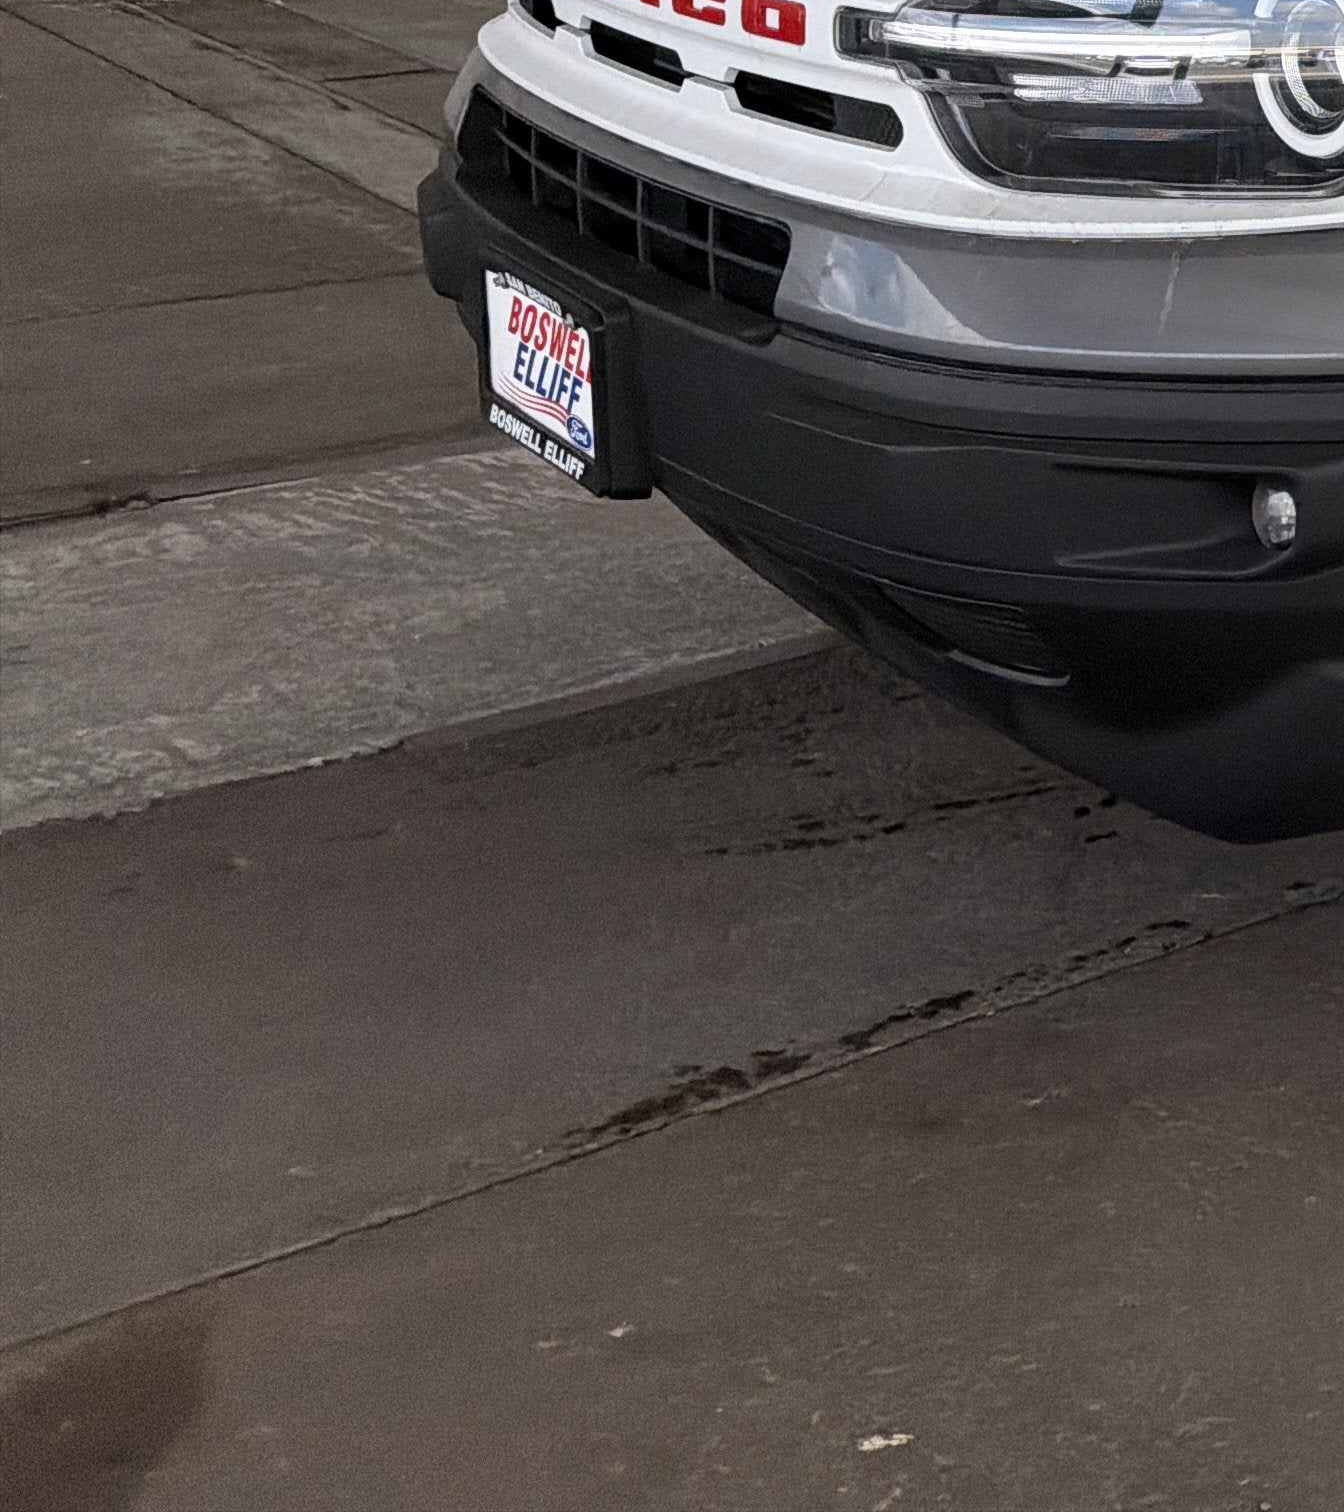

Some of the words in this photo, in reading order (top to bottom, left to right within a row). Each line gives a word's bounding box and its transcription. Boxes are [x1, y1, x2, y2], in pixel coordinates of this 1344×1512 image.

[513, 340, 583, 416] ELLIFF
[489, 403, 542, 455] BOSWELL
[543, 438, 586, 481] ELLIFF
[569, 419, 589, 447] Ford
